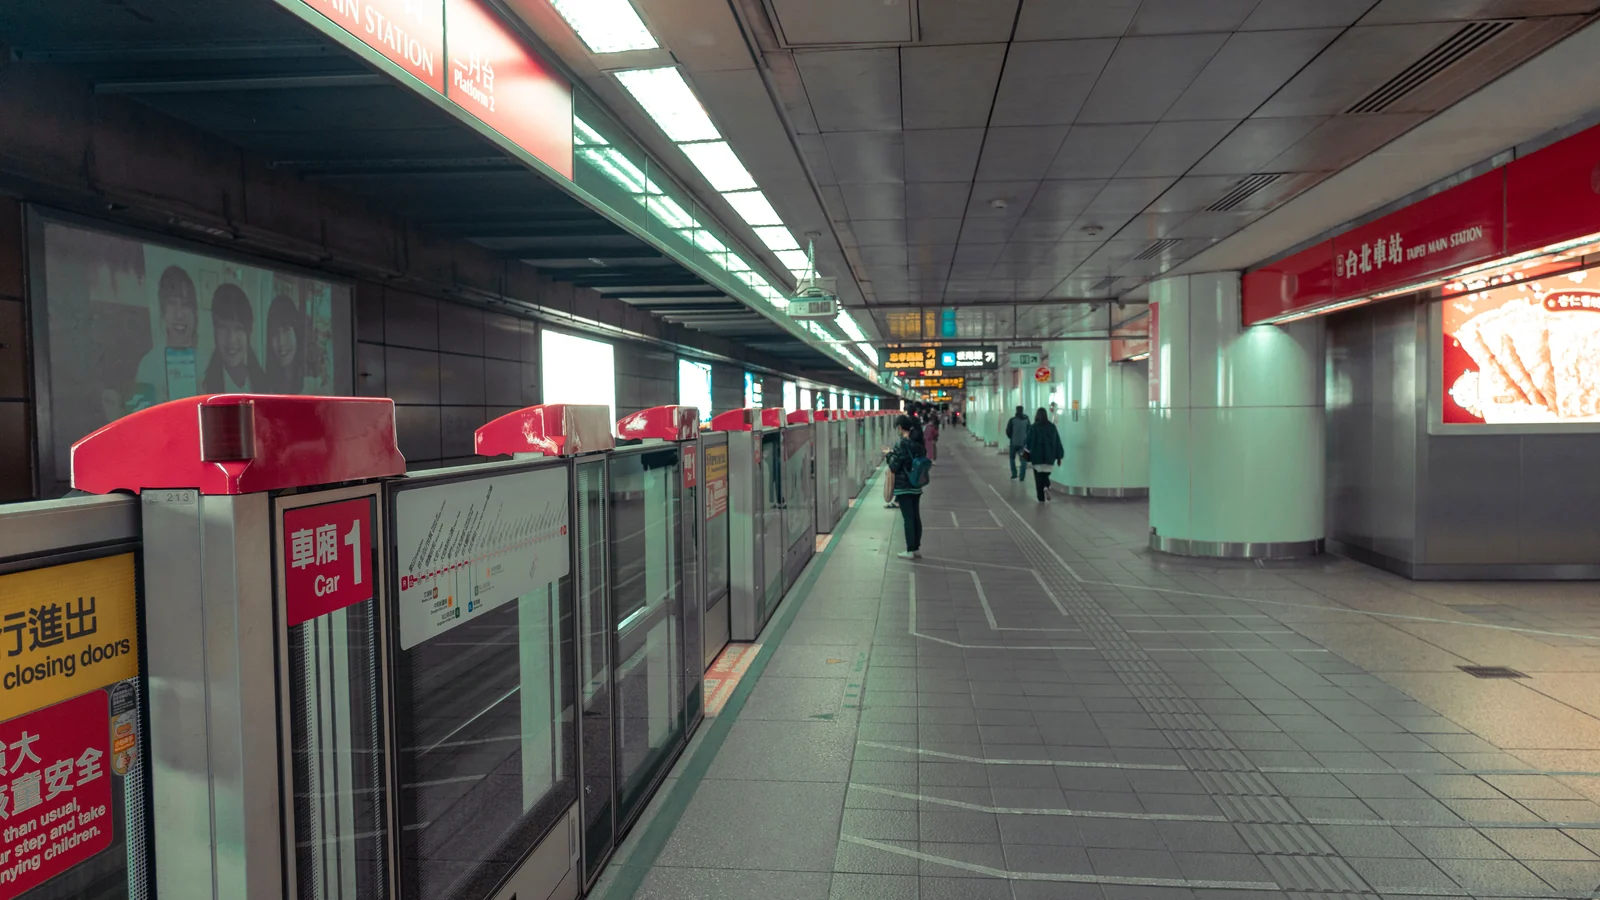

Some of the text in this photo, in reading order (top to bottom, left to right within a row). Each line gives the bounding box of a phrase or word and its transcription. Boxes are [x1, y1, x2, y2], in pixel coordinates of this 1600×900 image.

[365, 5, 433, 76] STATION
[454, 68, 495, 112] Platform 2
[1346, 232, 1403, 279] 台北車站
[1406, 225, 1483, 261] TAIPEI MAIN STATION
[167, 493, 189, 502] 213
[291, 523, 338, 570] 車廂
[344, 519, 362, 585] 1
[314, 574, 340, 597] Car
[3, 638, 131, 690] closing doors
[3, 797, 80, 844] than usual,
[15, 833, 46, 857] step
[50, 816, 75, 840] and
[78, 805, 106, 826] take
[44, 826, 100, 861] children.
